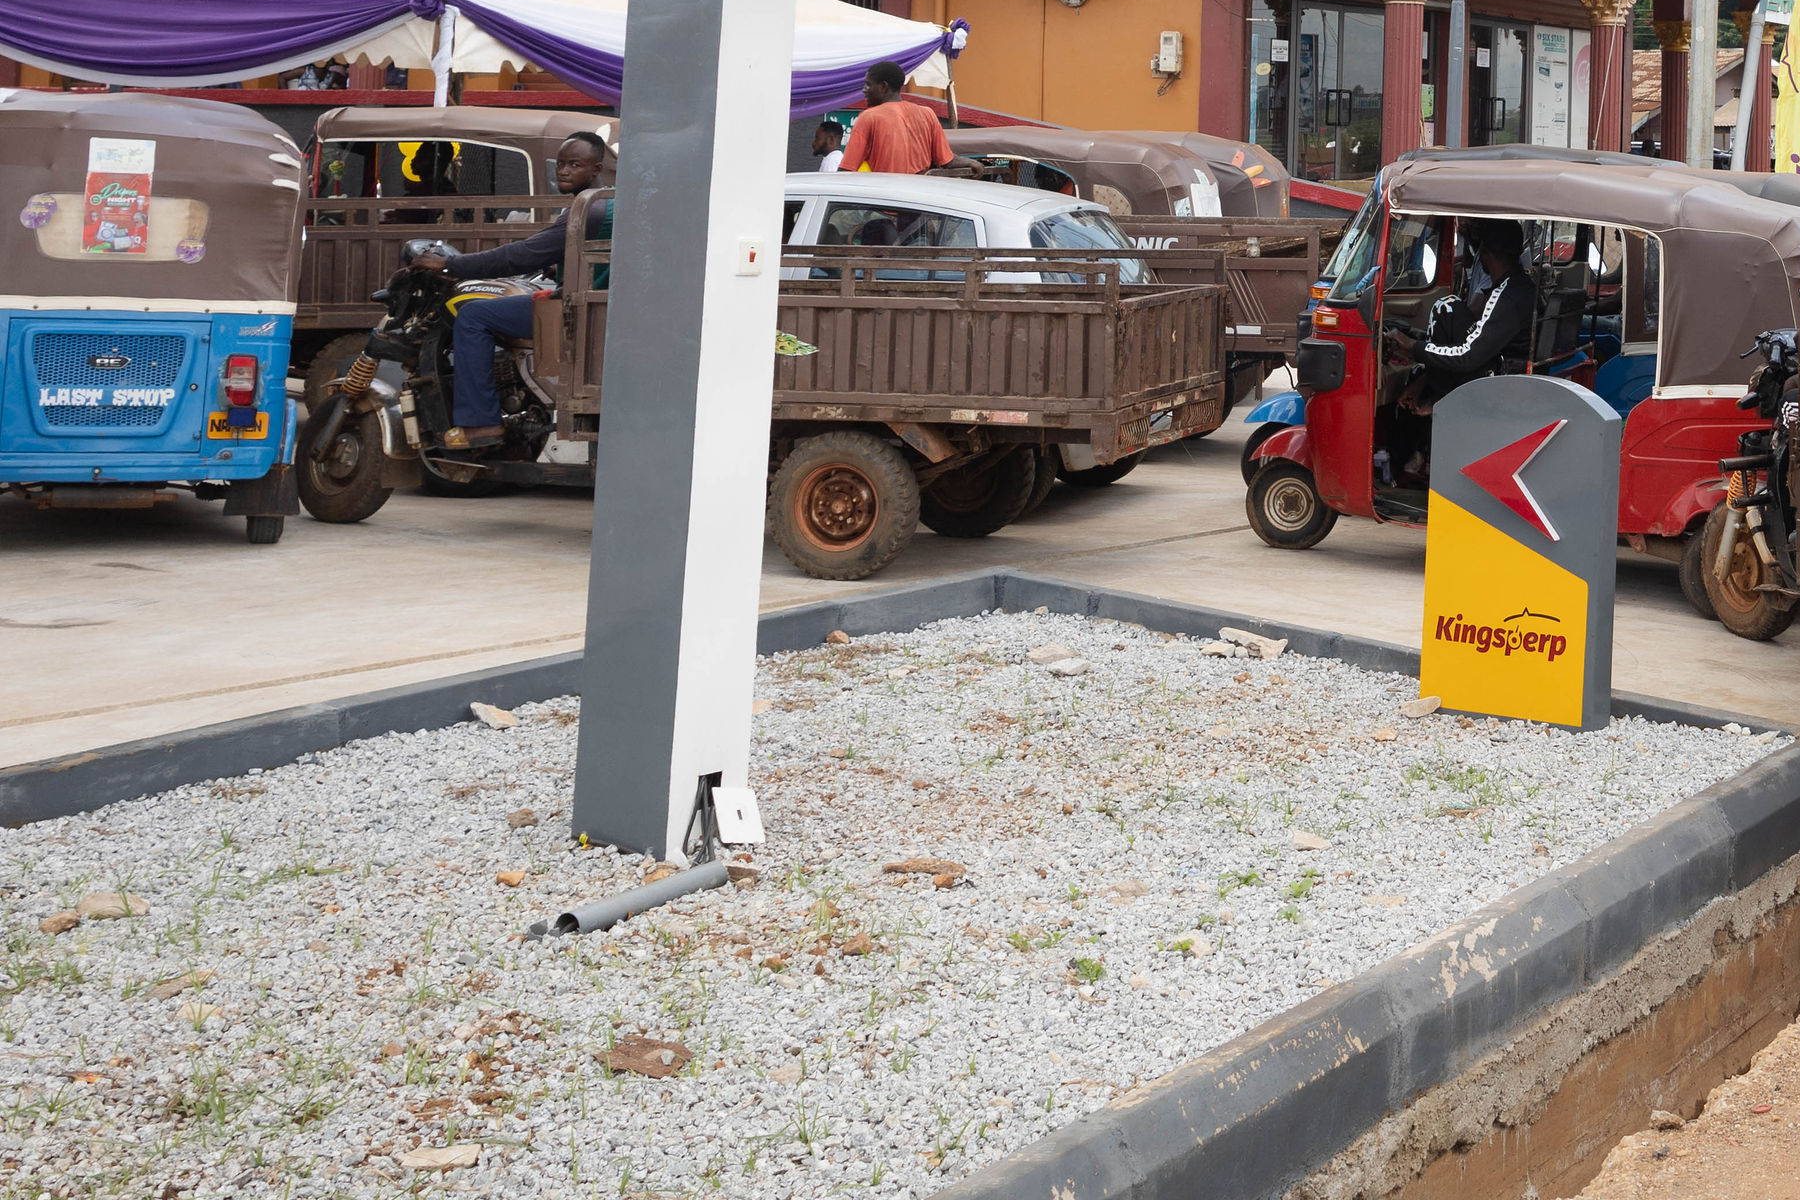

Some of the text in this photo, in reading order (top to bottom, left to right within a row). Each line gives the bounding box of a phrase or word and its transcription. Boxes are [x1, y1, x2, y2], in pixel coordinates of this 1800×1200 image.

[461, 285, 506, 294] APSONIC
[38, 387, 176, 407] LAST STOP
[1435, 613, 1567, 662] Kingsperp
